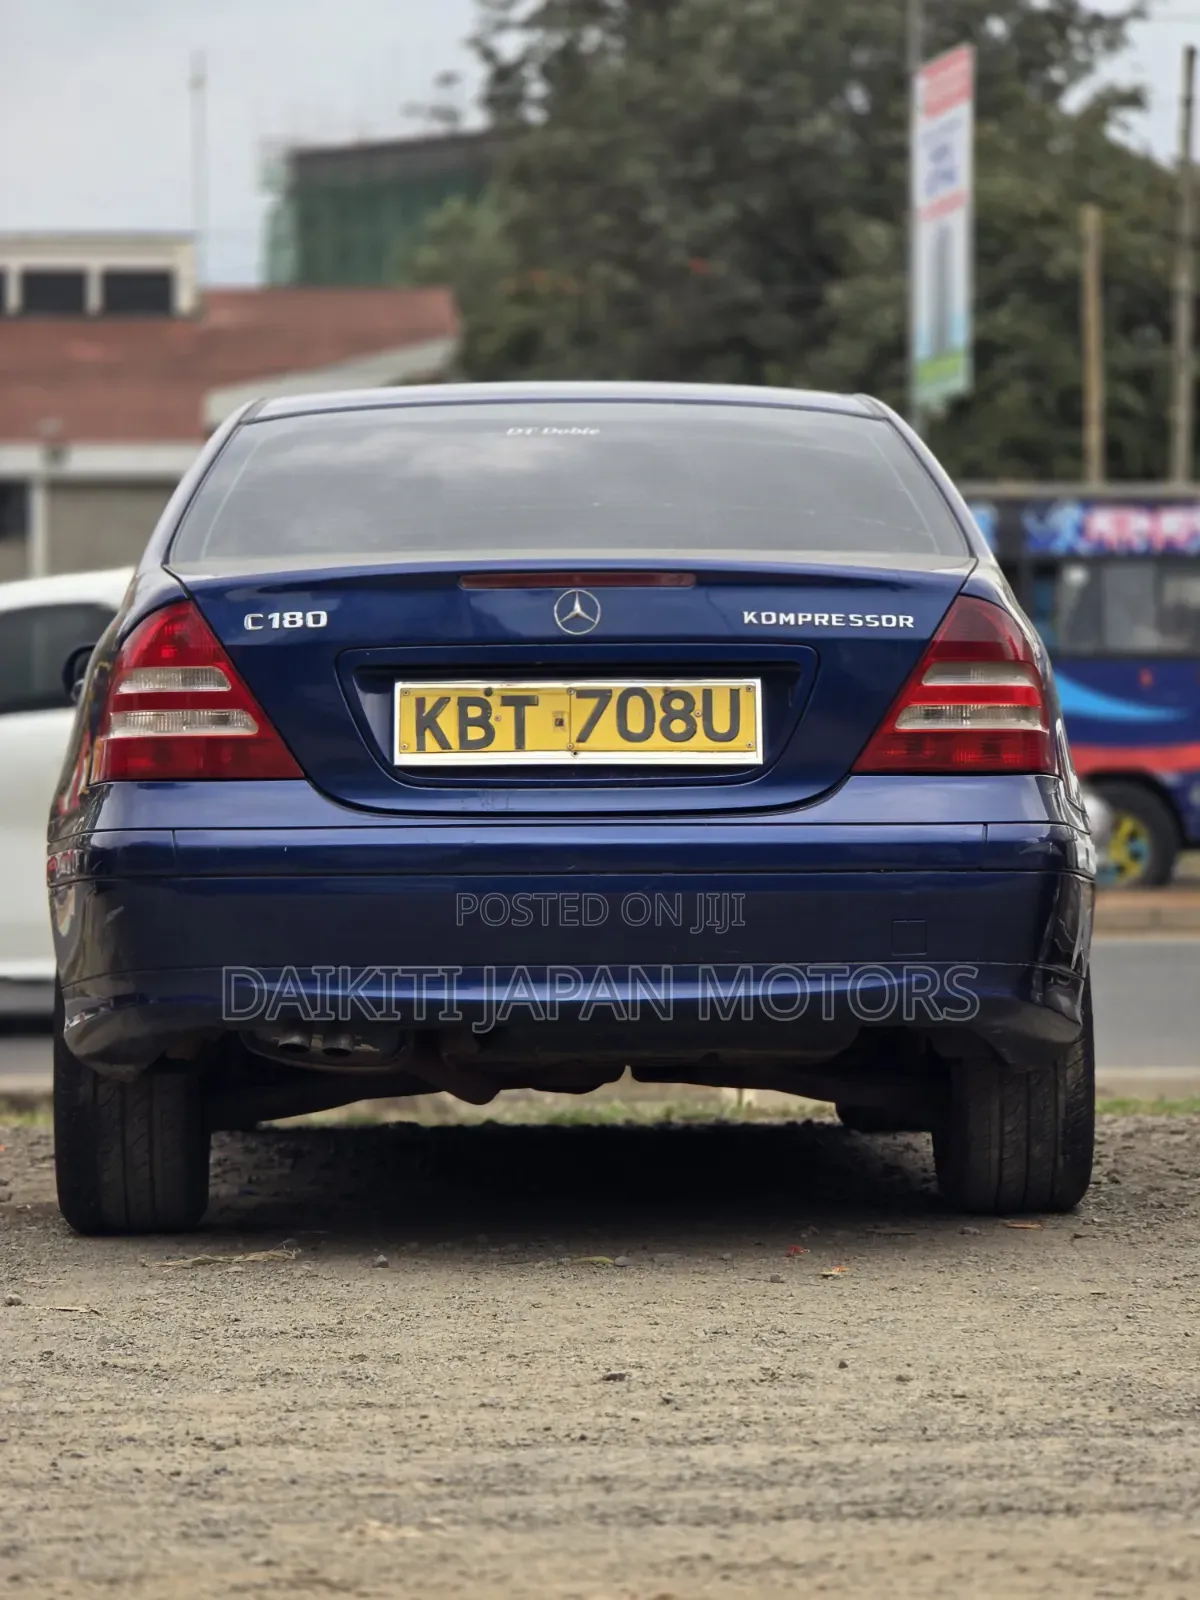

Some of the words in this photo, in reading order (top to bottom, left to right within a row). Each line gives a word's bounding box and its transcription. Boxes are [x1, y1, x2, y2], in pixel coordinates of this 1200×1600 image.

[506, 427, 539, 436] DT
[742, 610, 915, 629] KOMPRESSOR
[414, 694, 539, 752] KBT
[575, 686, 741, 744] 708U
